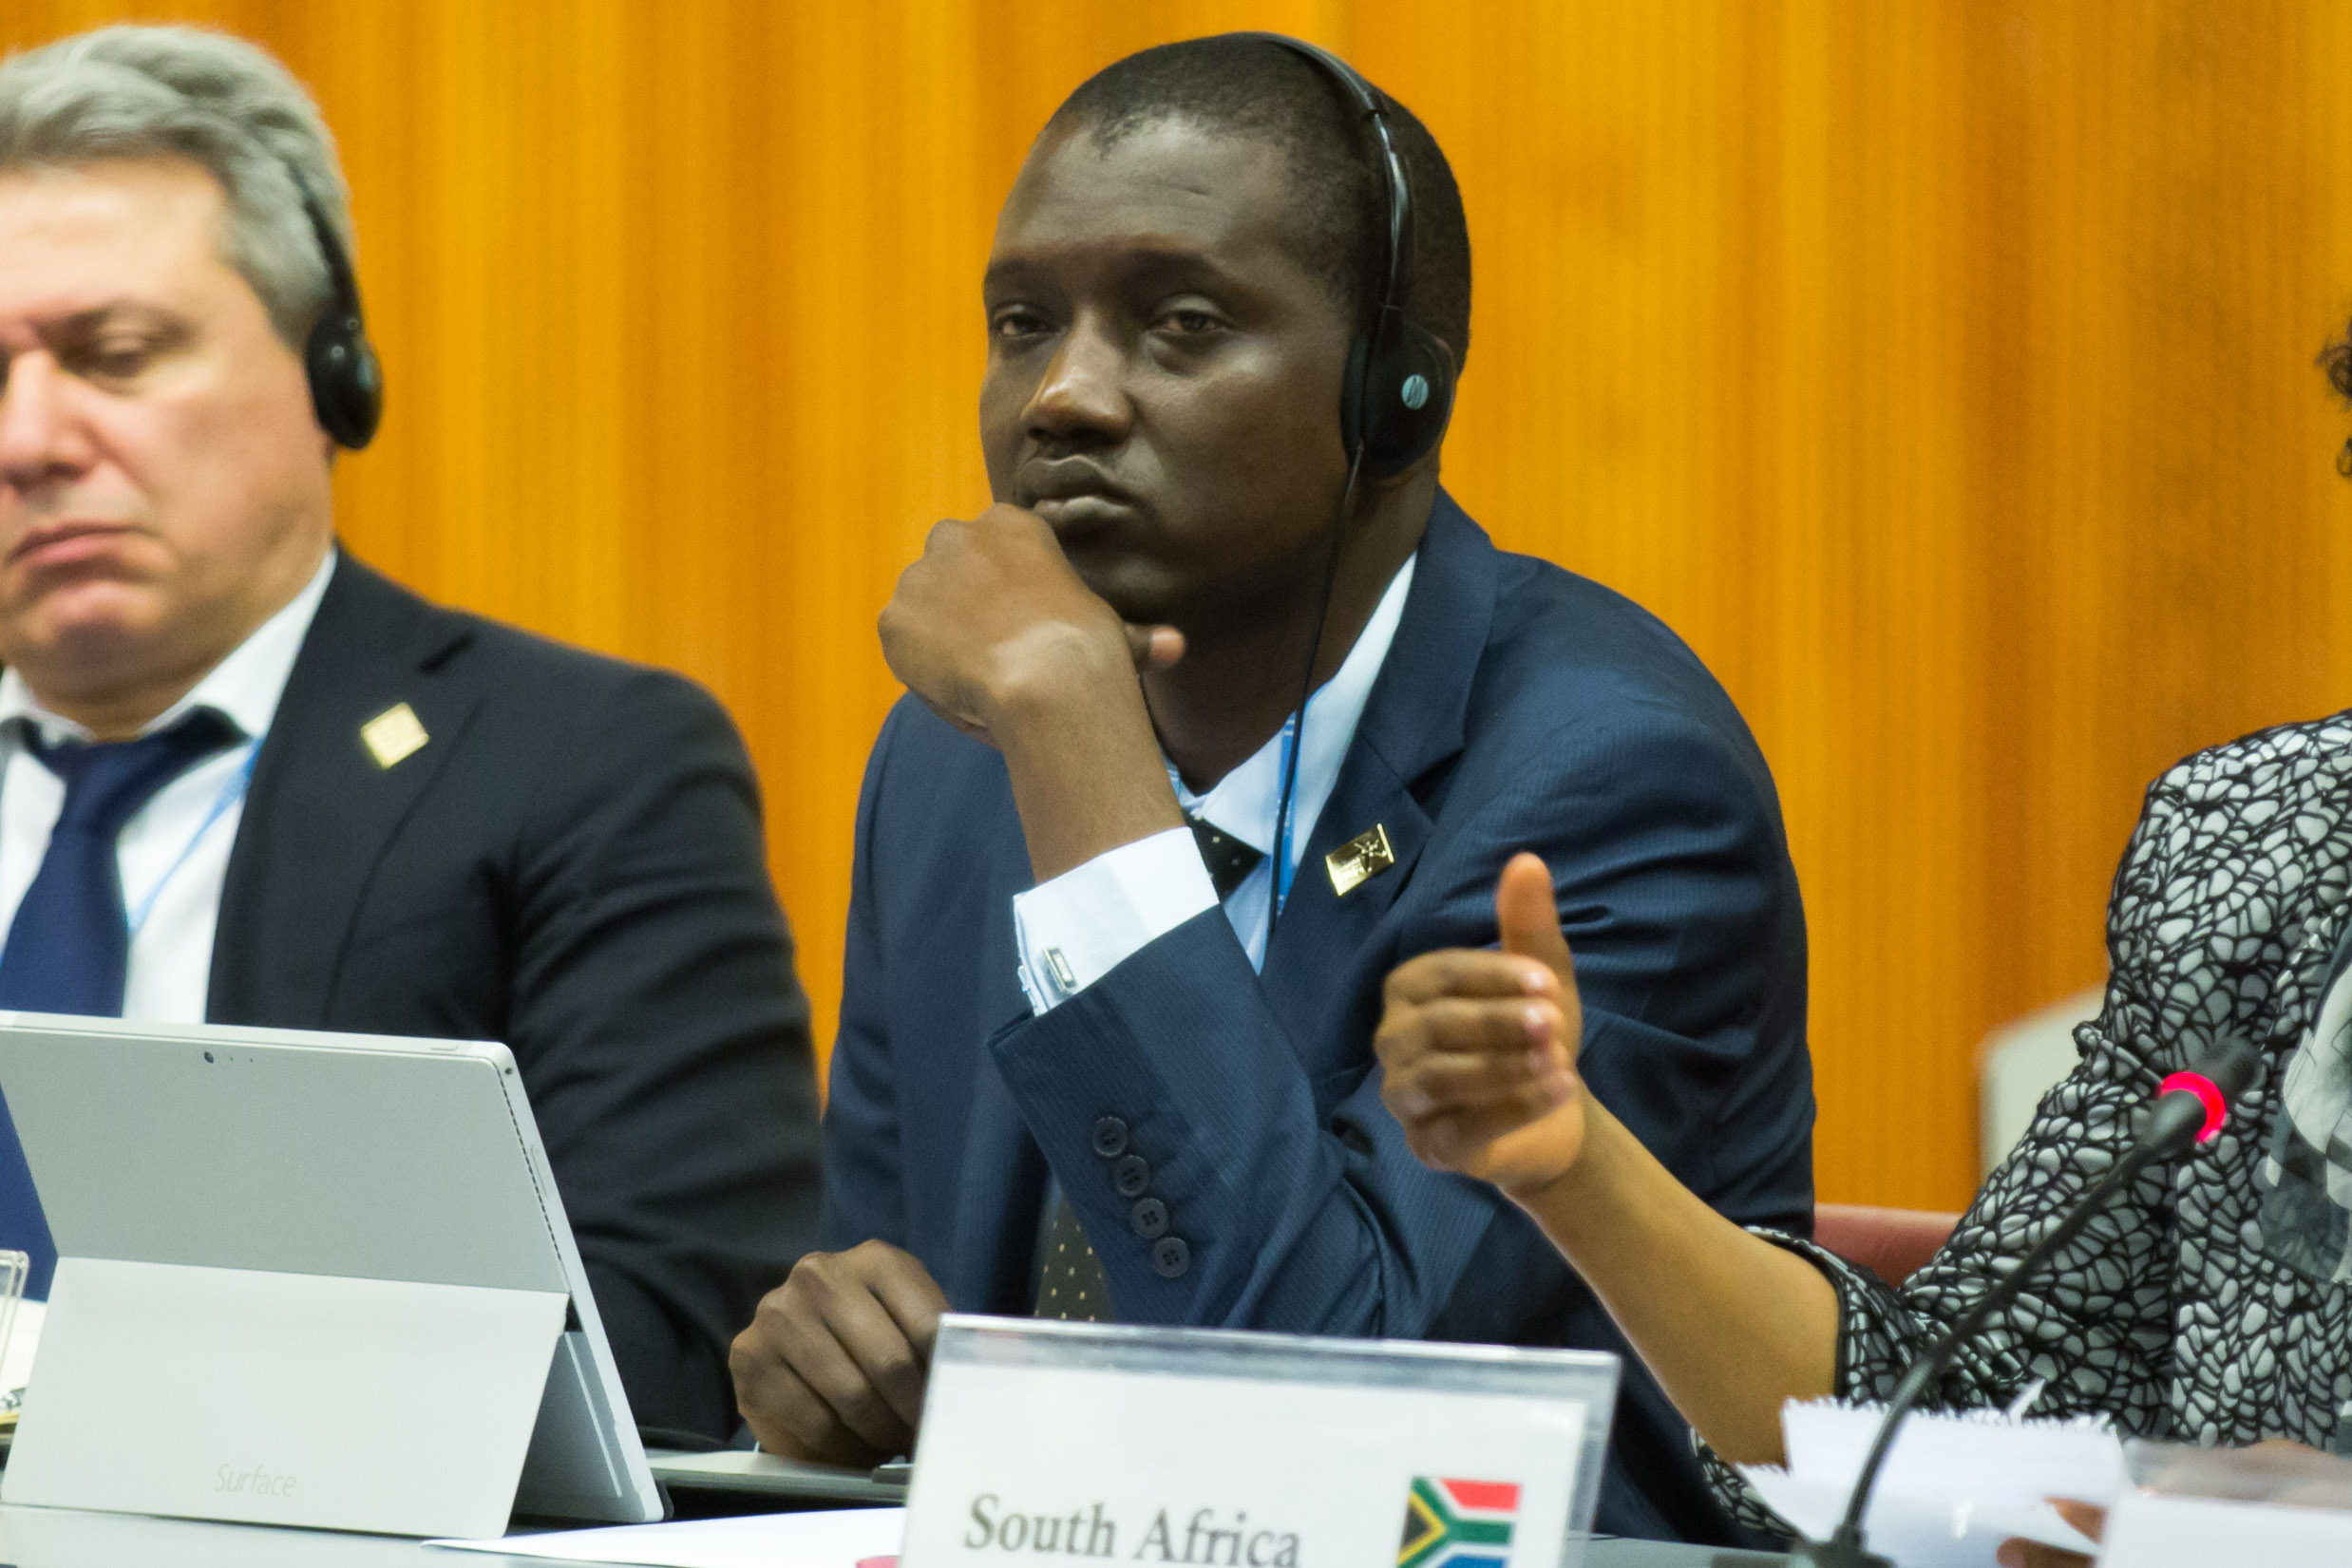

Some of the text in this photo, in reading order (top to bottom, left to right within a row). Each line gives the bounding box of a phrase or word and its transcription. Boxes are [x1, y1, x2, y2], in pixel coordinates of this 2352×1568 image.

[214, 1463, 297, 1498] Surface
[963, 1493, 1301, 1568] South Africa
